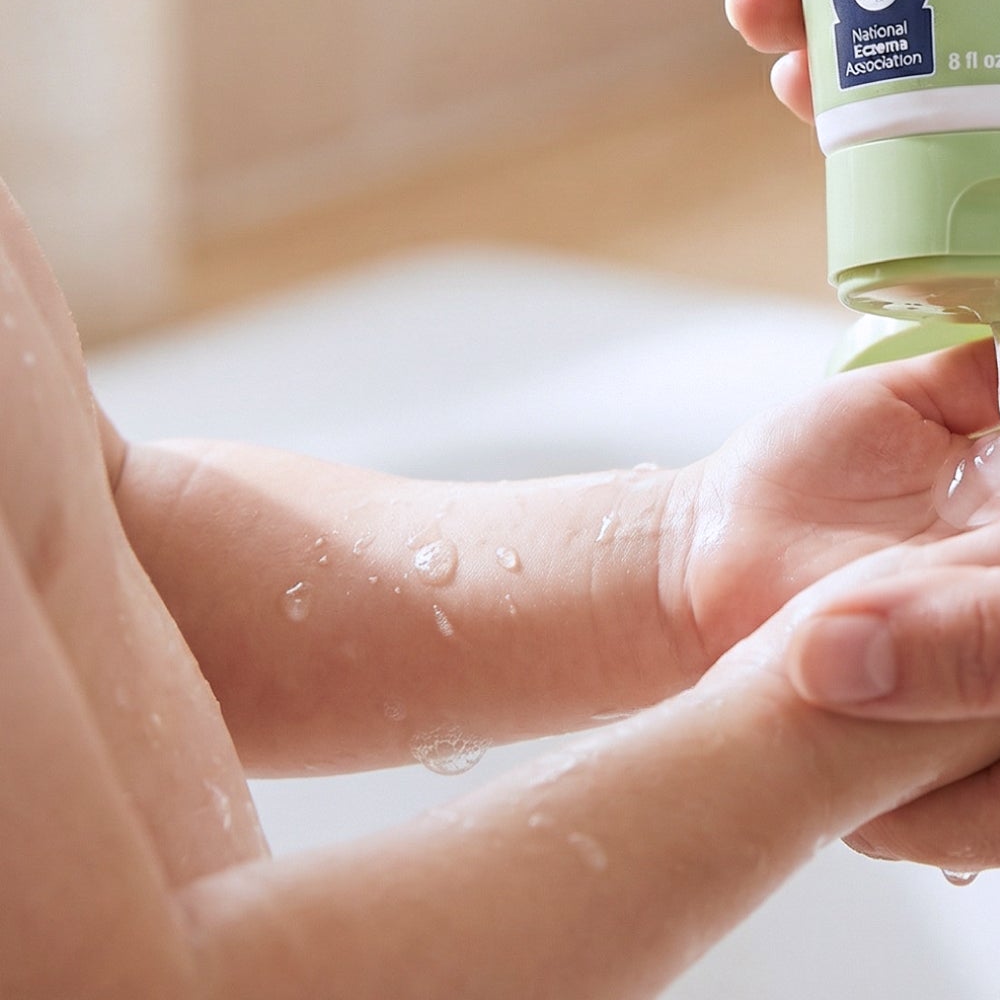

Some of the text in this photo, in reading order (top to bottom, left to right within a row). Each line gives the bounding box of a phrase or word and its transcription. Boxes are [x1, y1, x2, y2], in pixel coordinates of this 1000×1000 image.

[852, 20, 908, 44] National
[948, 52, 961, 71] 8
[965, 51, 978, 69] fl
